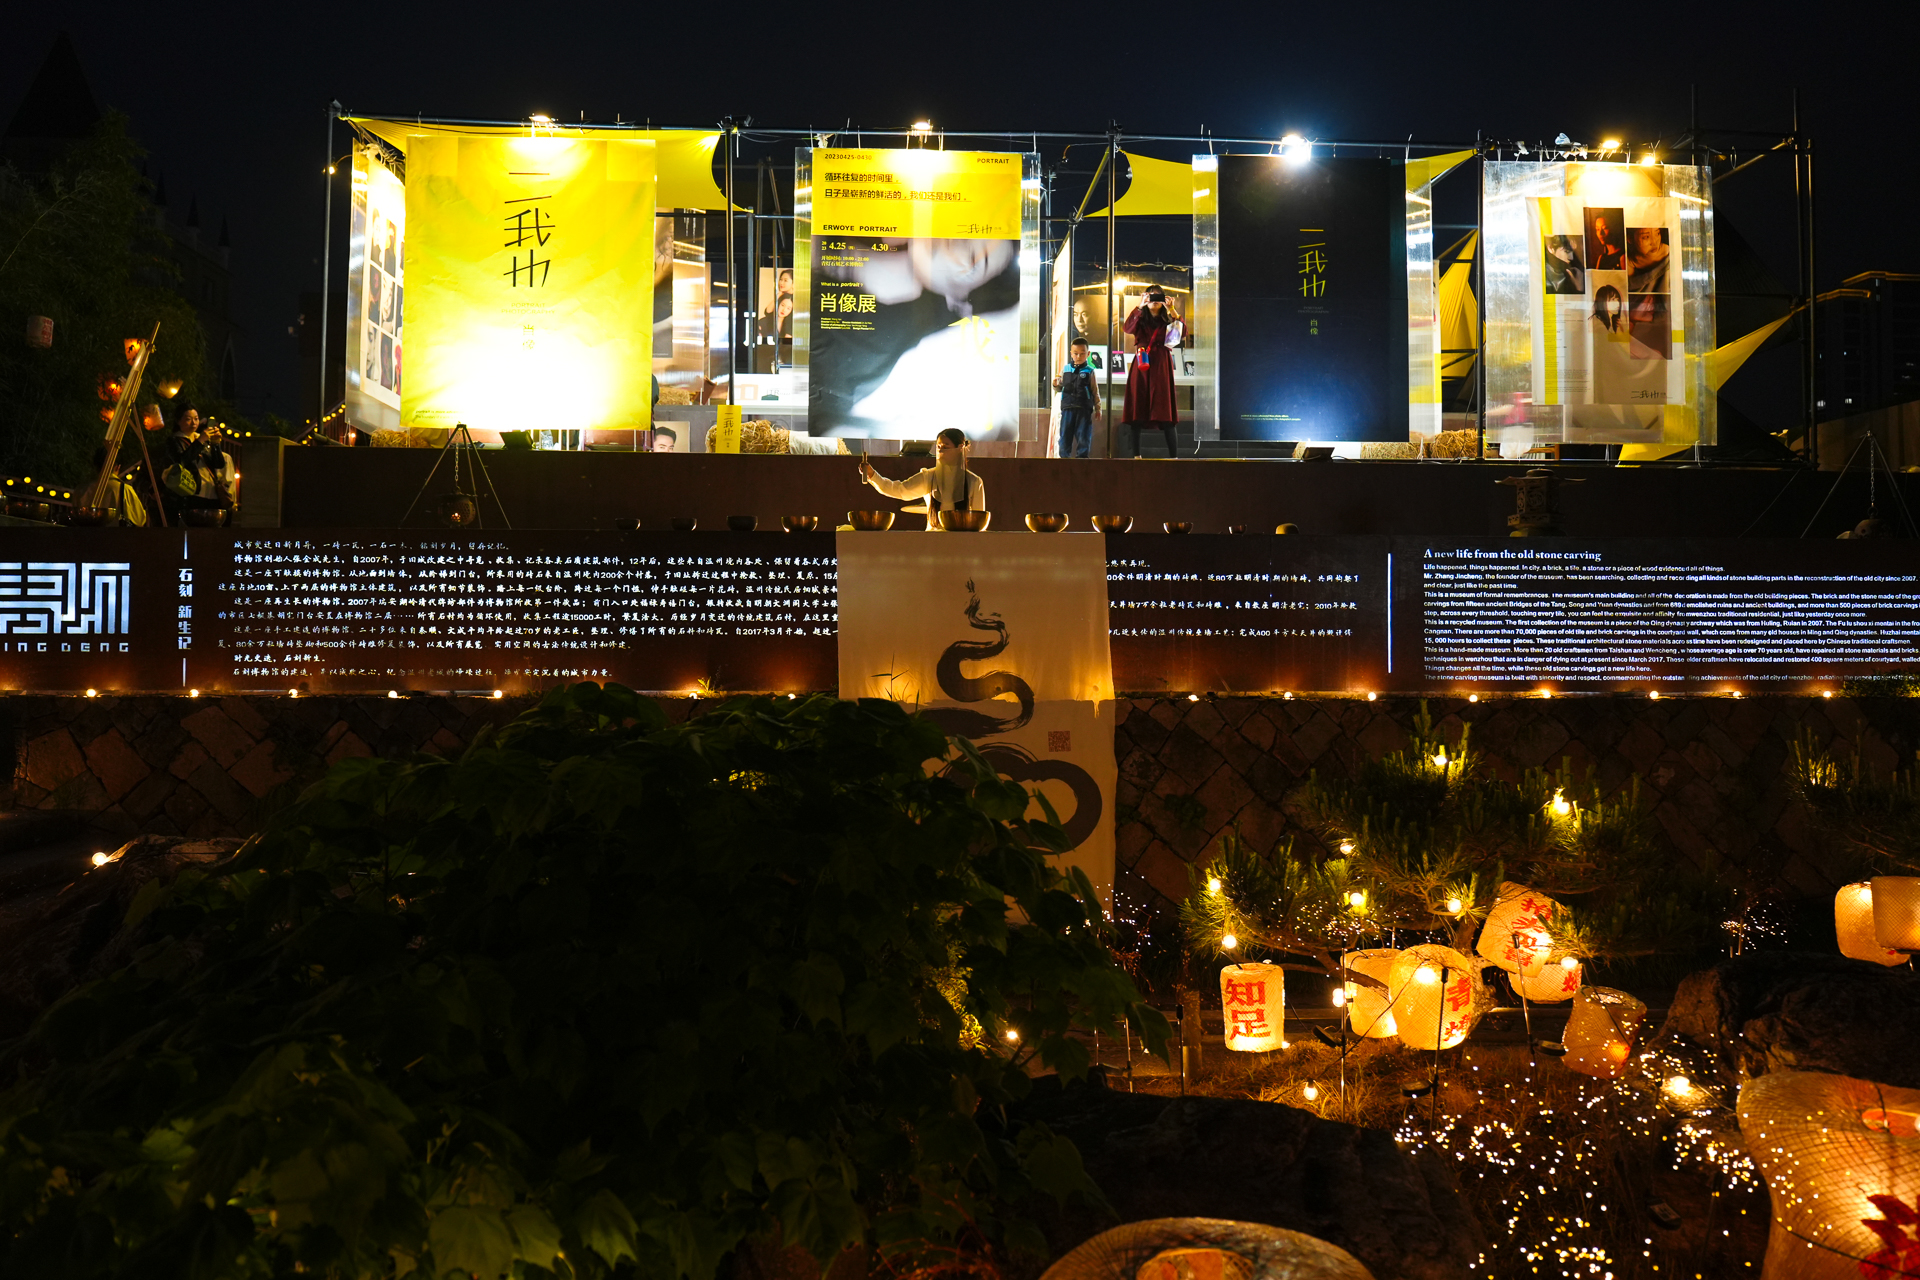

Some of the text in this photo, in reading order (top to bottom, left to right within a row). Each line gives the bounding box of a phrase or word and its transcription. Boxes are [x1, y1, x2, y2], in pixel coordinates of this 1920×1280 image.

[871, 244, 889, 252] 4.30
[821, 293, 876, 314] 肖像展
[1424, 549, 1432, 559] A
[1456, 550, 1472, 559] life
[1474, 550, 1498, 559] from
[1500, 550, 1516, 560] the
[1535, 550, 1562, 560] stone
[1564, 551, 1601, 563] carving
[178, 568, 193, 650] 石刻 新生记
[1226, 978, 1271, 1041] 知足
